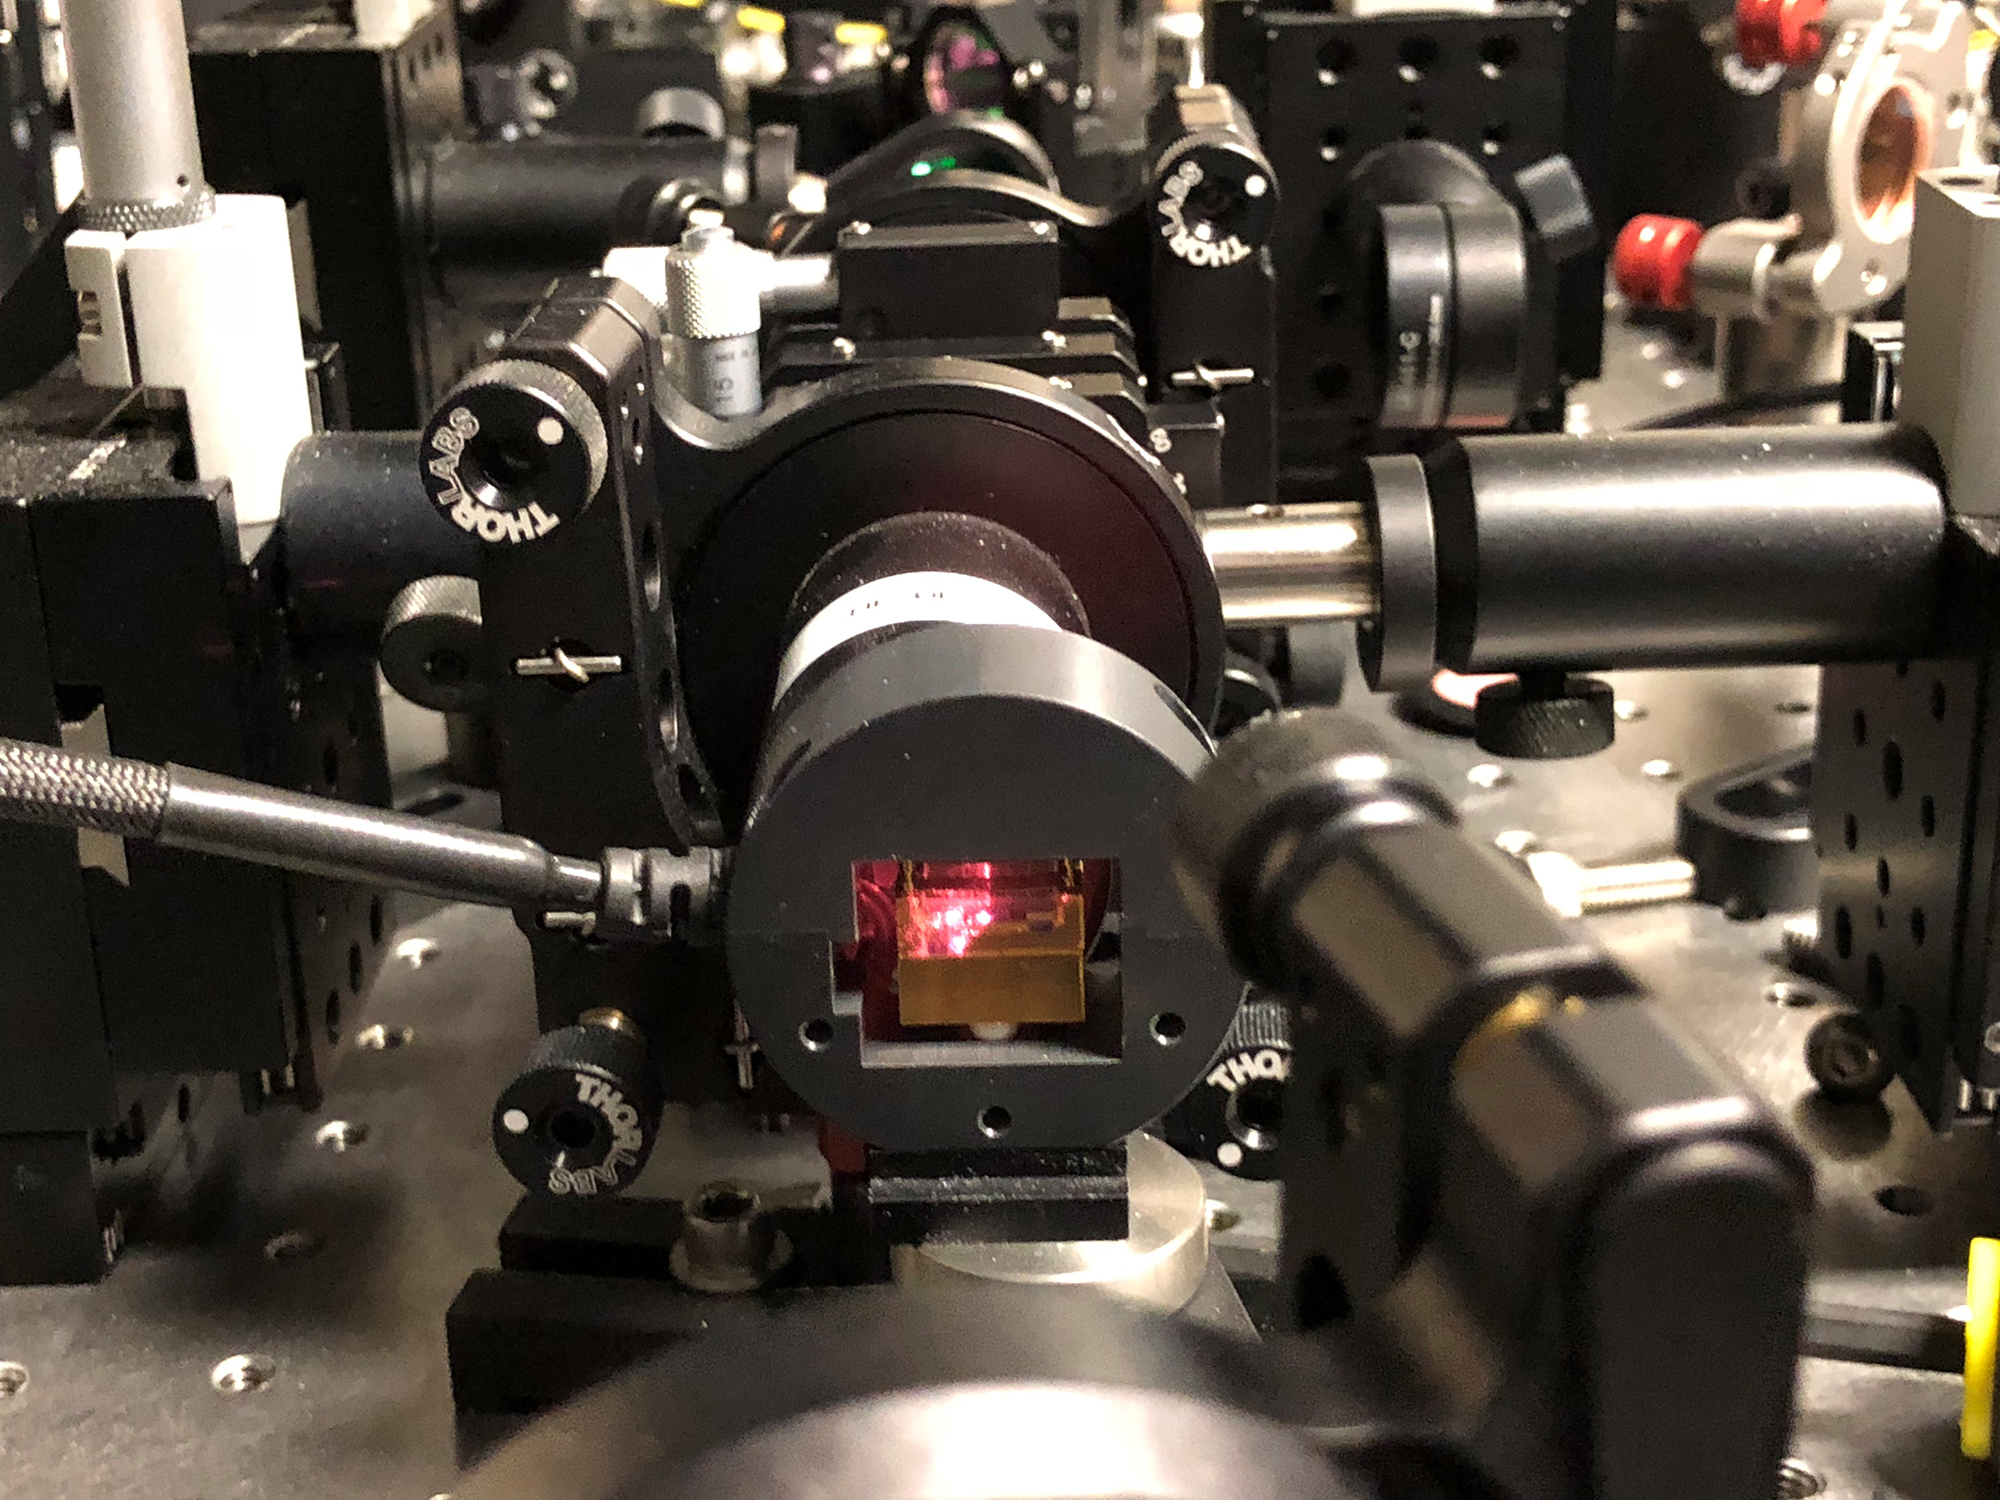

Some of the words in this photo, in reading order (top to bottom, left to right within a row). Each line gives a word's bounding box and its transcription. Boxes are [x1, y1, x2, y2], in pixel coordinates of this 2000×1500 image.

[1157, 160, 1252, 268] THORLABS
[428, 406, 561, 544] THORLABS
[548, 1072, 643, 1195] THORLABS
